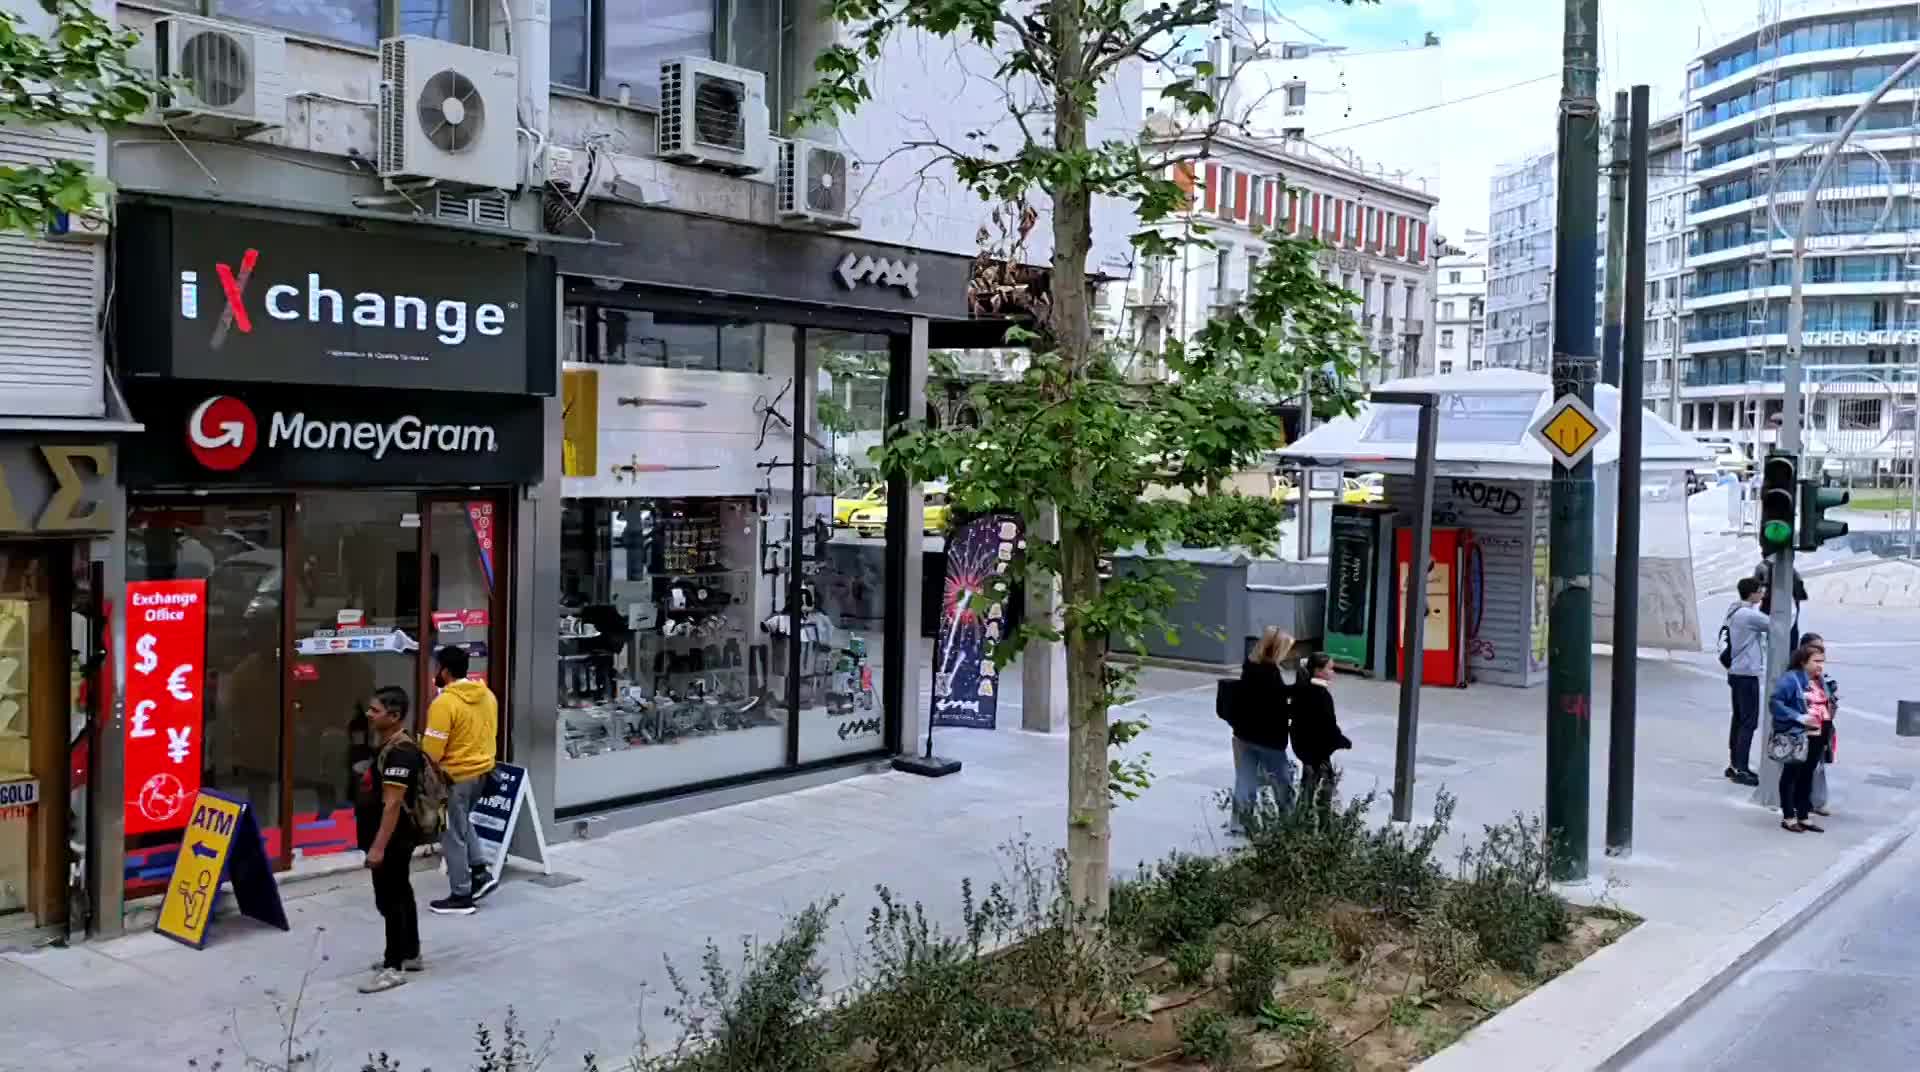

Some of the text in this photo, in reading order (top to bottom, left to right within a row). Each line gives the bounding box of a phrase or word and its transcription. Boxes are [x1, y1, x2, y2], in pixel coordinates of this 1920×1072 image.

[268, 411, 495, 460] MoneyGram
[132, 592, 198, 607] Exchange
[144, 608, 184, 622] Office
[133, 633, 158, 675] $
[166, 664, 193, 701] €
[130, 700, 157, 738] £
[167, 726, 191, 763] ¥
[0, 784, 34, 804] GOLD
[192, 805, 233, 836] ATM
